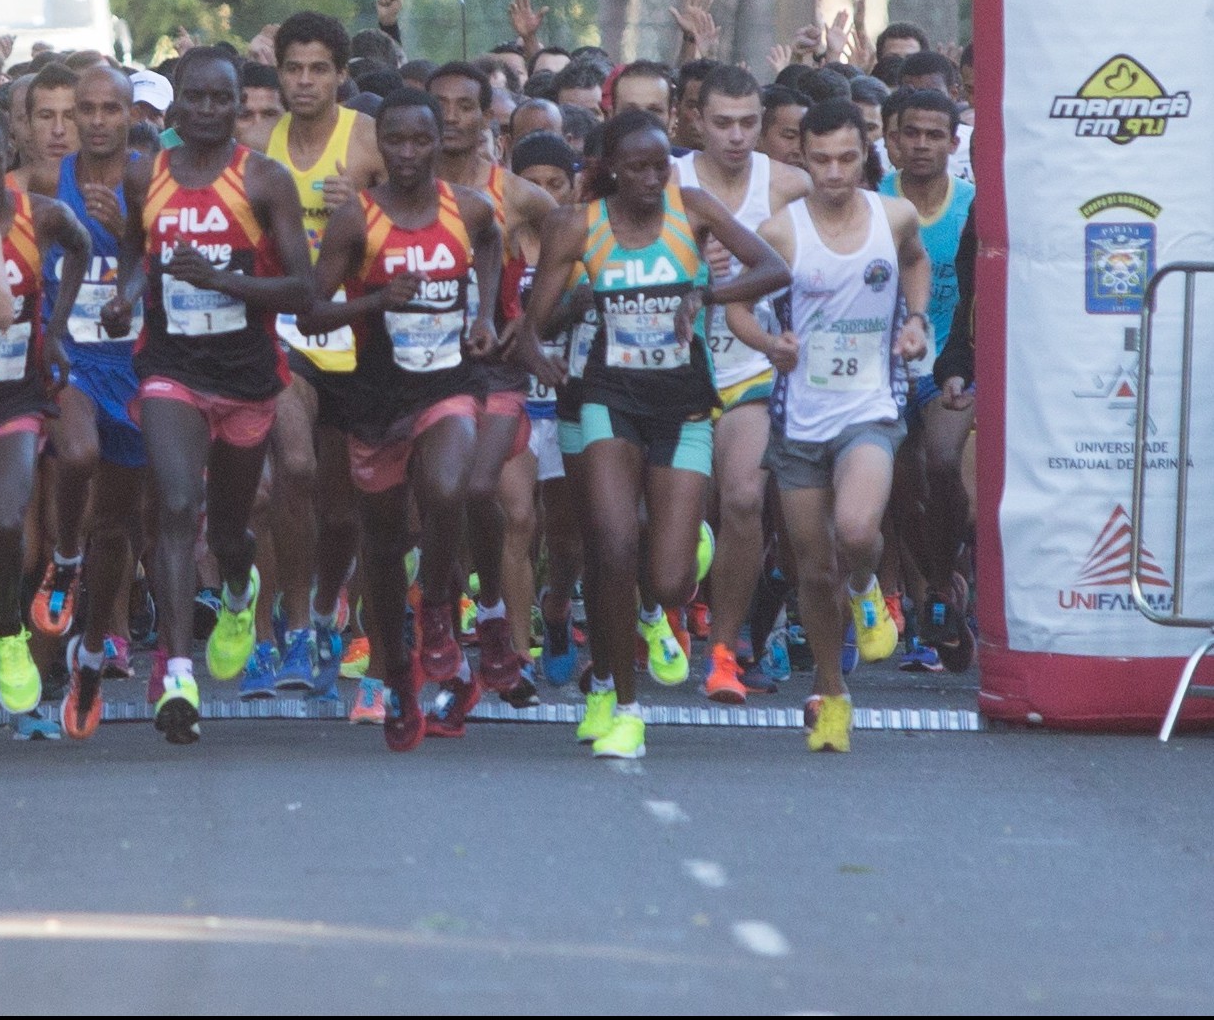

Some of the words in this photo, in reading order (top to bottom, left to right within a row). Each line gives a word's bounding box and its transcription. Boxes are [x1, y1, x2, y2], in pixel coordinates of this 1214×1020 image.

[1077, 118, 1121, 136] FM
[1124, 117, 1166, 135] 97.1
[158, 205, 230, 233] FILA
[384, 243, 456, 274] FILA
[603, 256, 678, 287] FILA
[708, 336, 734, 353] 27
[639, 348, 665, 366] 19
[831, 357, 859, 376] 28
[1075, 441, 1169, 454] UNIVERSIADE
[1048, 458, 1112, 470] ESTADUAL
[1116, 458, 1135, 470] DE
